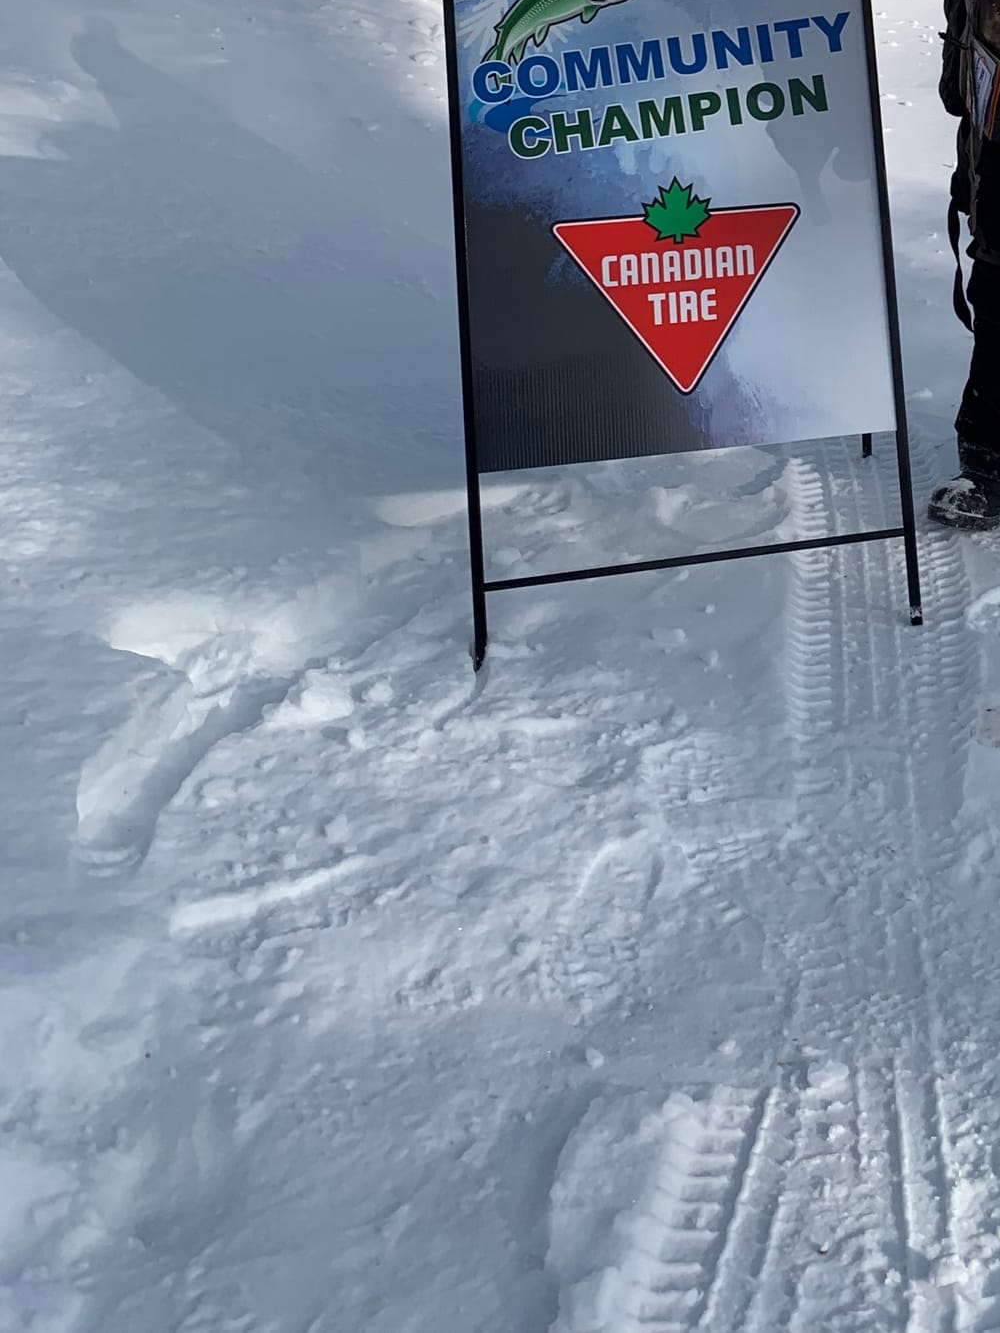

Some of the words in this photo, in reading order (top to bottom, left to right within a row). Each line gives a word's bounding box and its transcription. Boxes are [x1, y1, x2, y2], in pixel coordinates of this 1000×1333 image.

[472, 11, 850, 105] COMMUNITY
[508, 74, 830, 160] CHAMPION
[601, 244, 756, 288] CANADIAN
[647, 289, 718, 326] TIRE
